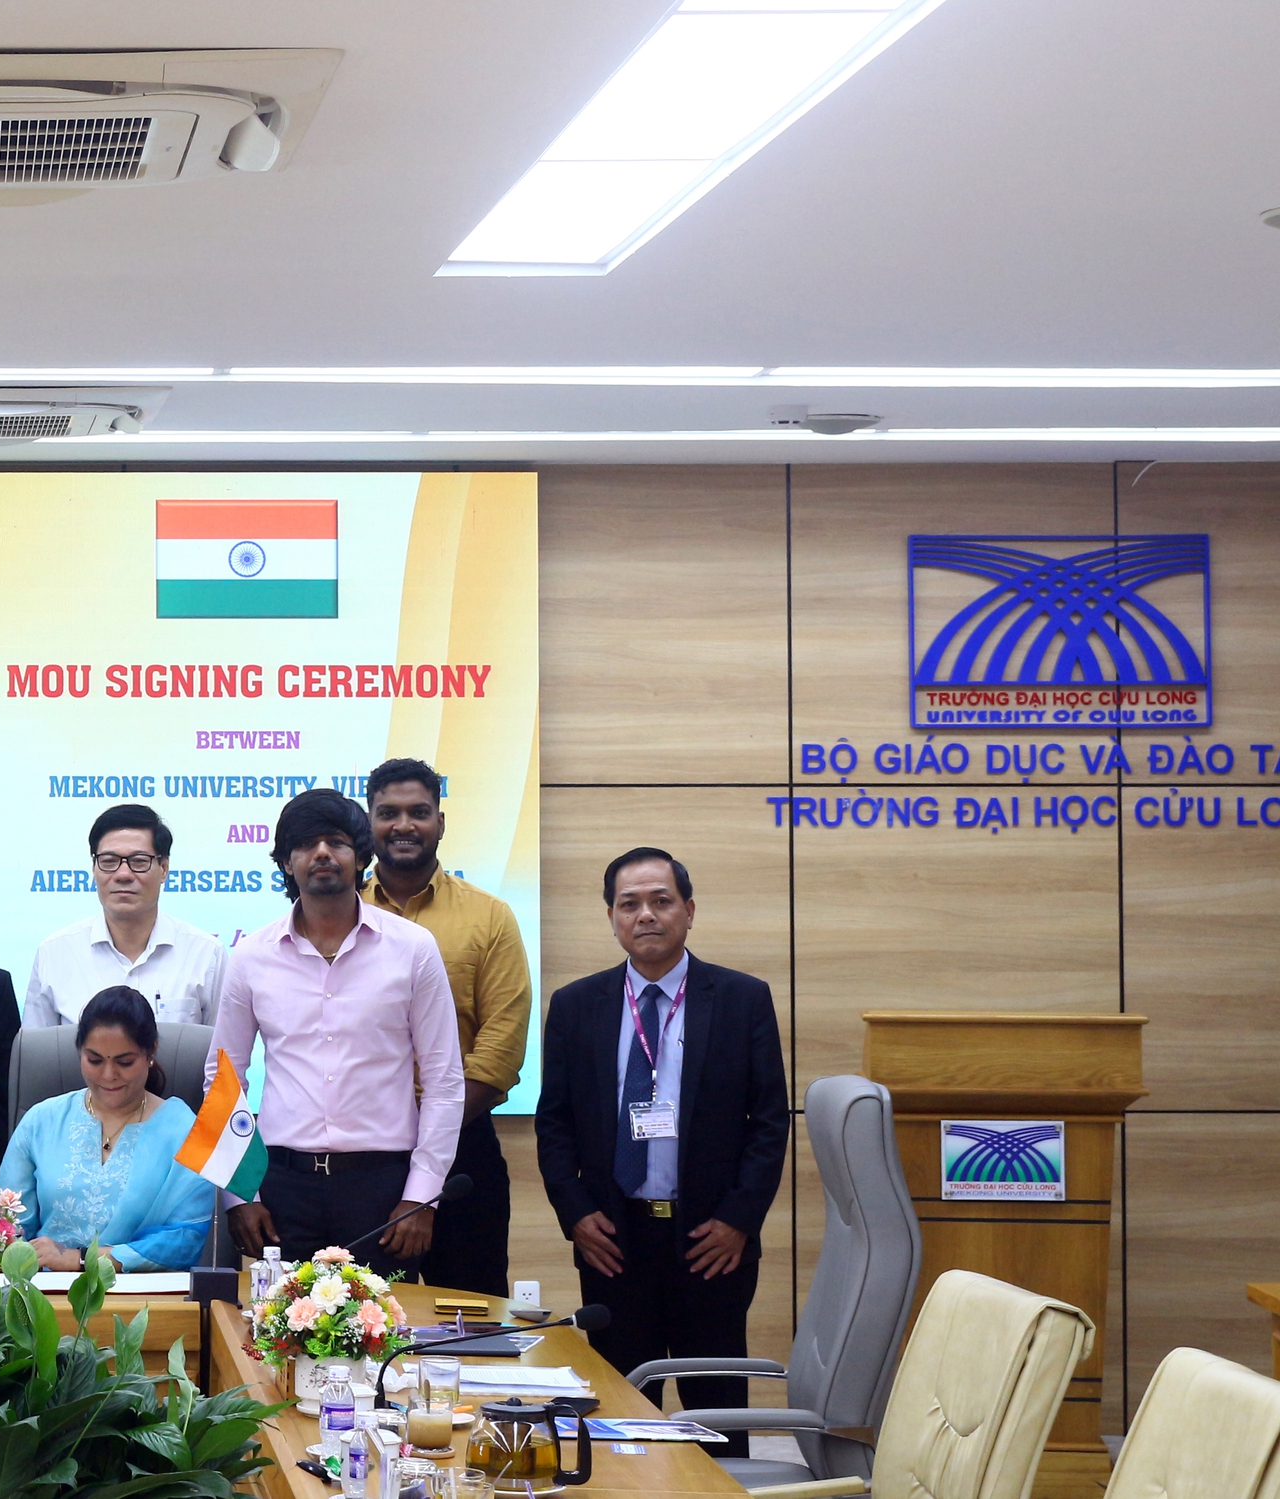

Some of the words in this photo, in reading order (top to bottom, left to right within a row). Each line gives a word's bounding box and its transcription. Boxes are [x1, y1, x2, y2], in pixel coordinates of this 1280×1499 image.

[6, 664, 92, 699] MOU
[105, 664, 263, 699] SIGNING
[277, 664, 492, 699] CEREMONY
[1015, 691, 1047, 708] ĐẠI
[1052, 691, 1093, 709] HỌC
[1145, 690, 1198, 705] LONG
[926, 709, 1046, 723] UNIVERSITY
[1052, 709, 1083, 723] OF
[1142, 708, 1198, 723] LONG
[195, 730, 301, 750] BETWEEN
[801, 738, 858, 784] BỘ
[874, 735, 970, 775] GIÁO
[986, 743, 1066, 784] DỤC
[1080, 736, 1132, 774] VÀ
[1147, 735, 1235, 775] ĐÀO
[1250, 744, 1280, 774] T
[49, 775, 155, 798] MEKONG
[766, 788, 940, 829] TRƯỜNG
[954, 796, 1019, 834] ĐẠI
[1034, 795, 1117, 834] HỌC
[1134, 788, 1222, 828] CỬU
[227, 824, 270, 843] AND
[30, 869, 98, 893] AIER
[162, 869, 263, 893] ERSEAS
